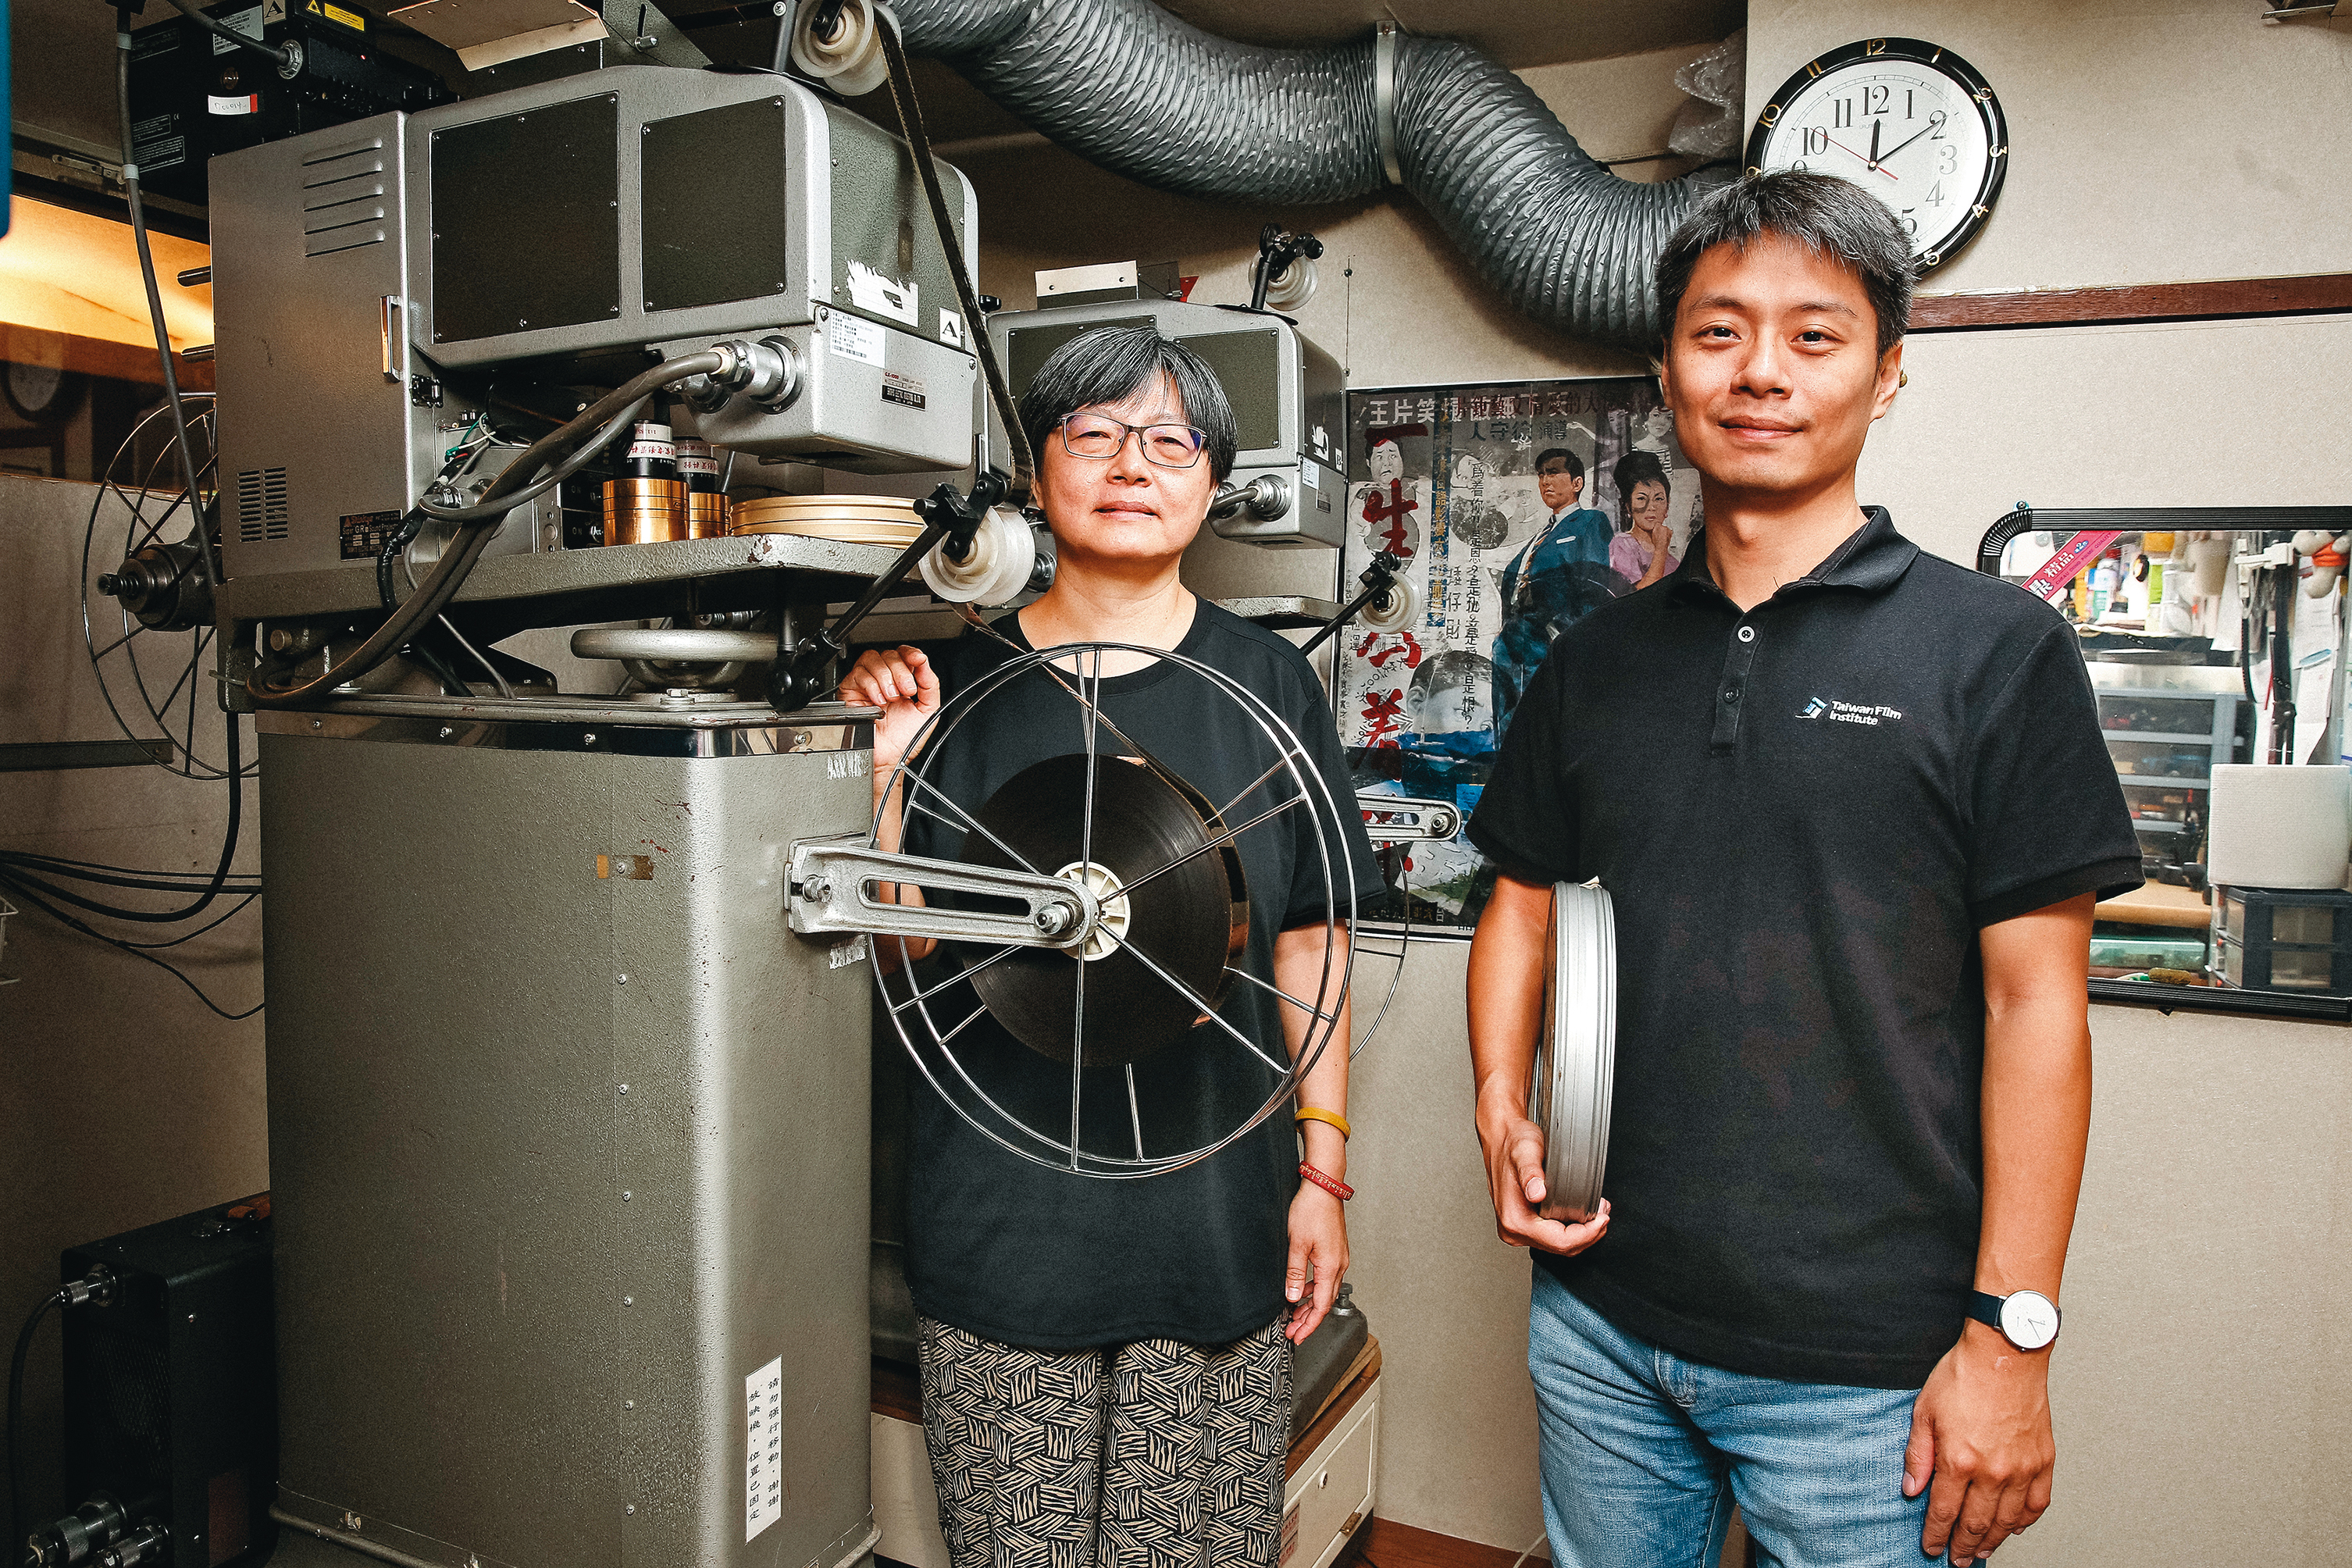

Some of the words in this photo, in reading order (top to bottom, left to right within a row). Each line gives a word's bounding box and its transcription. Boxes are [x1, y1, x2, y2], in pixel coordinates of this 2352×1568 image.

[265, 0, 284, 18] A
[1867, 39, 1886, 55] 12
[1833, 98, 1854, 128] 11
[1862, 85, 1889, 116] 12
[1905, 89, 1915, 119] 1
[1929, 110, 1948, 140] 2
[1801, 127, 1828, 156] 10
[1940, 145, 1958, 174] 3
[1926, 180, 1945, 207] 4
[1901, 207, 1917, 235] 5
[1923, 248, 1940, 265] 5
[942, 320, 958, 338] A
[1336, 454, 1342, 466] B
[1829, 710, 1879, 726] Institute
[1830, 700, 1875, 715] Taiwan
[1875, 705, 1903, 720] Film
